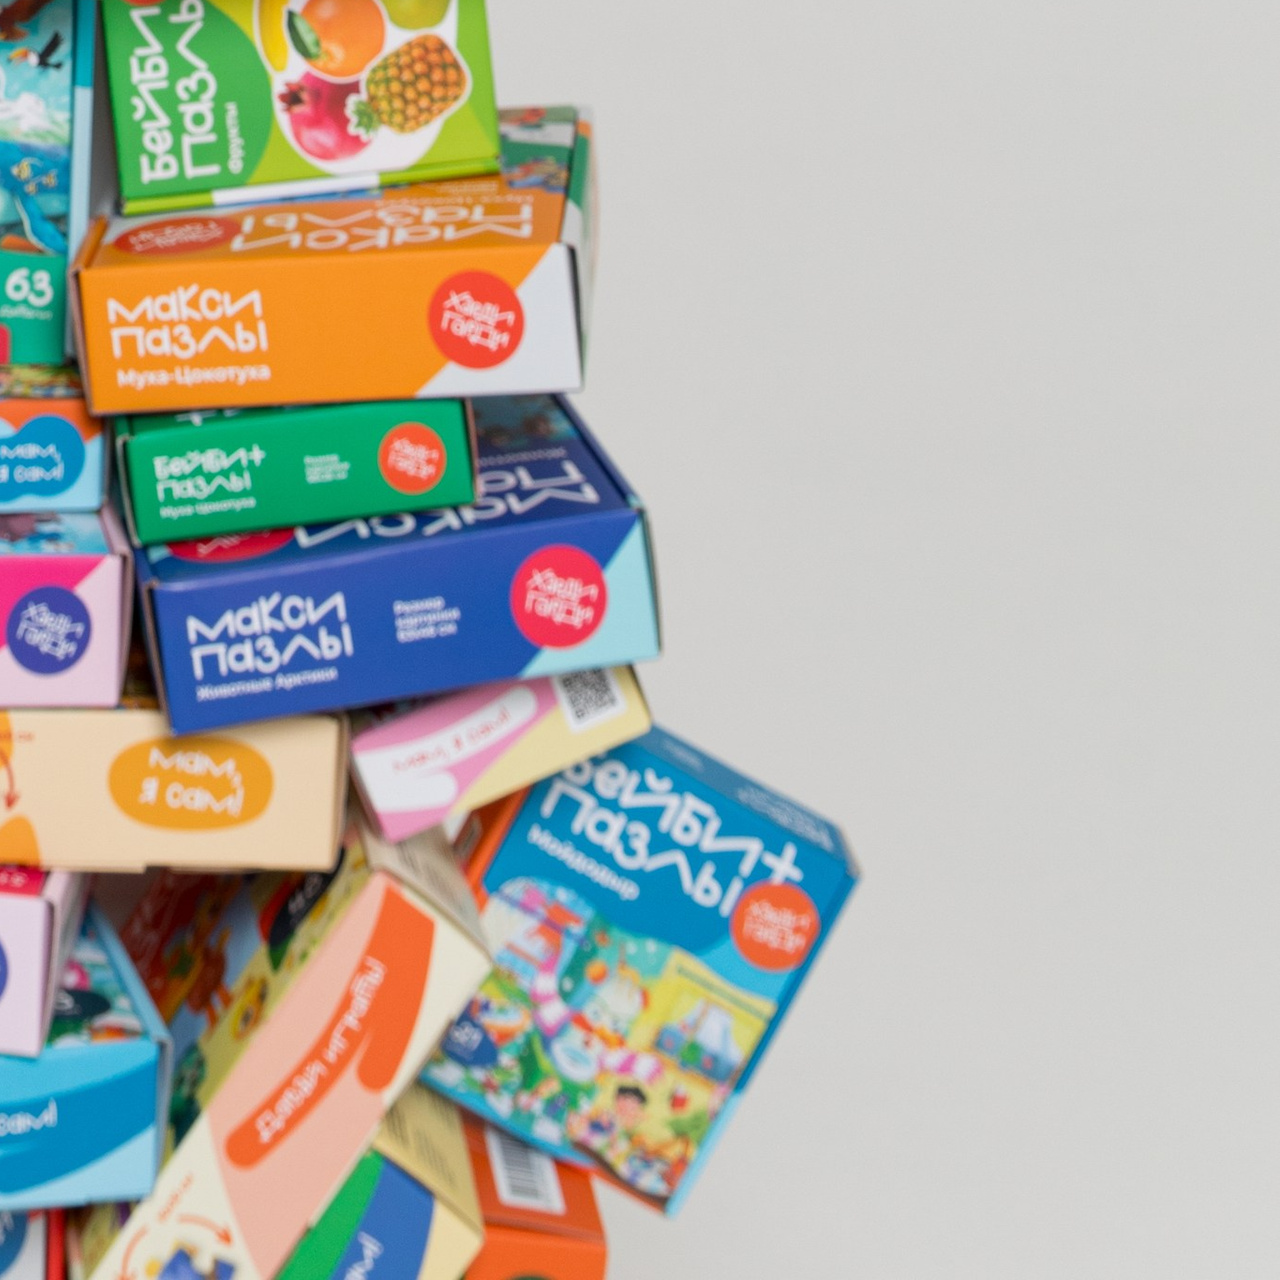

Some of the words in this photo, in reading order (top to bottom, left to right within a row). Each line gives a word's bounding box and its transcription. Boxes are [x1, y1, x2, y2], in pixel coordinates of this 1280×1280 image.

[224, 101, 246, 174] Фрукты
[4, 267, 54, 307] 63
[117, 364, 271, 390] Муха-Цокотуха
[196, 676, 273, 702] Животные
[274, 666, 338, 690] Арктики
[139, 777, 160, 805] я
[165, 782, 245, 817] сам!
[527, 823, 640, 901] Мойдодыр
